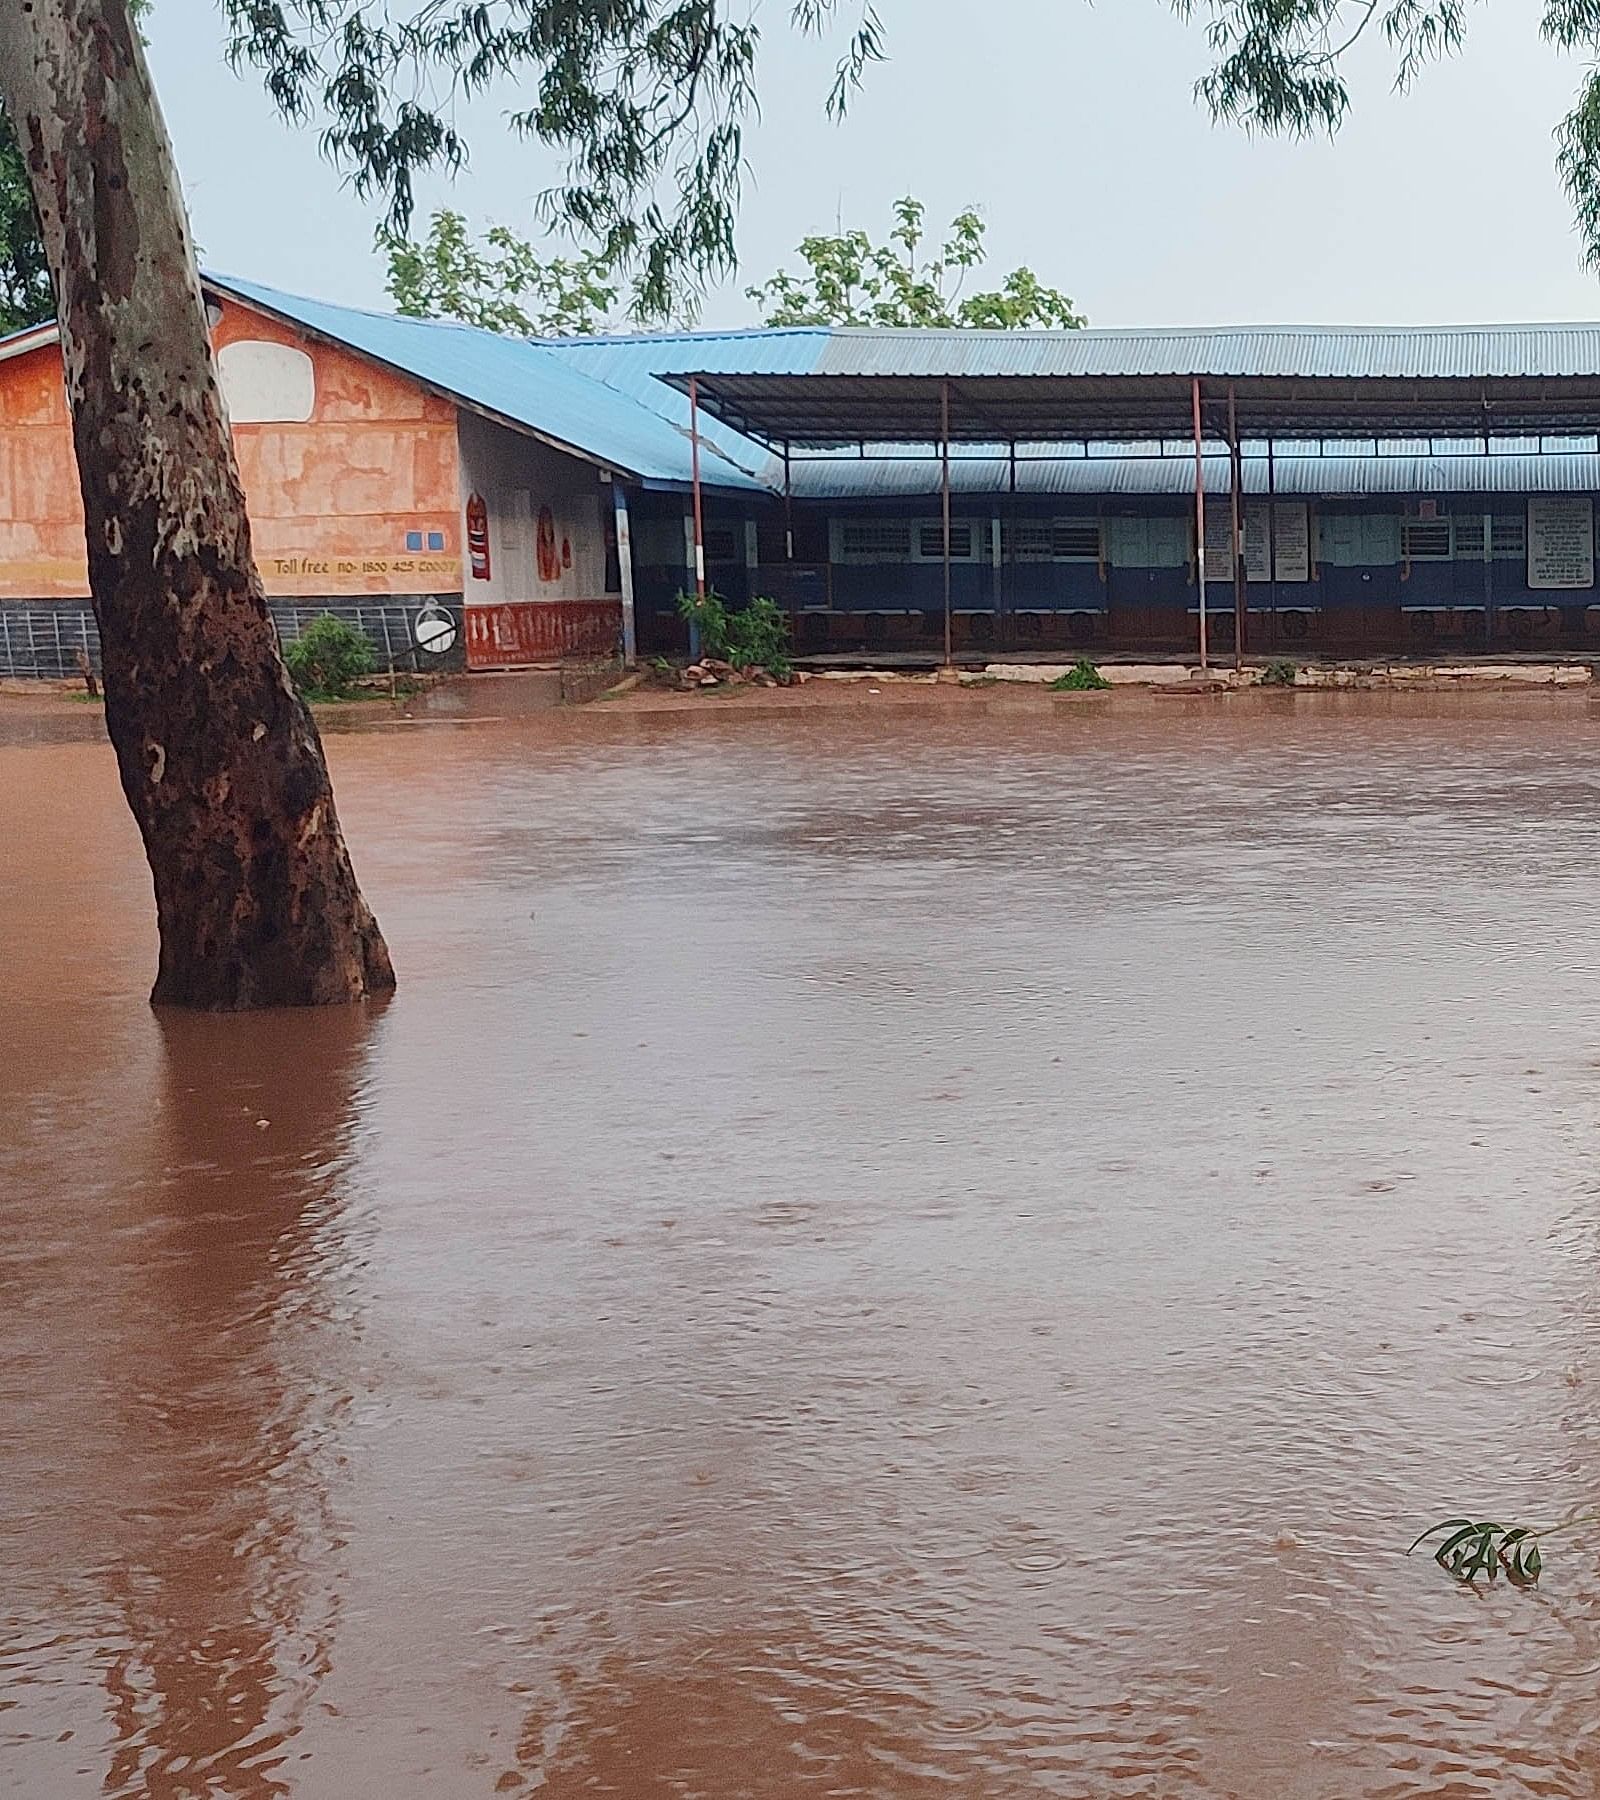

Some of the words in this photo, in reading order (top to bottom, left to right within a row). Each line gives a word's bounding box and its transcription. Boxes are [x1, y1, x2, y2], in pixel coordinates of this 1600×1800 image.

[274, 558, 297, 574] Toll
[301, 558, 329, 574] free
[362, 561, 388, 573] 1800
